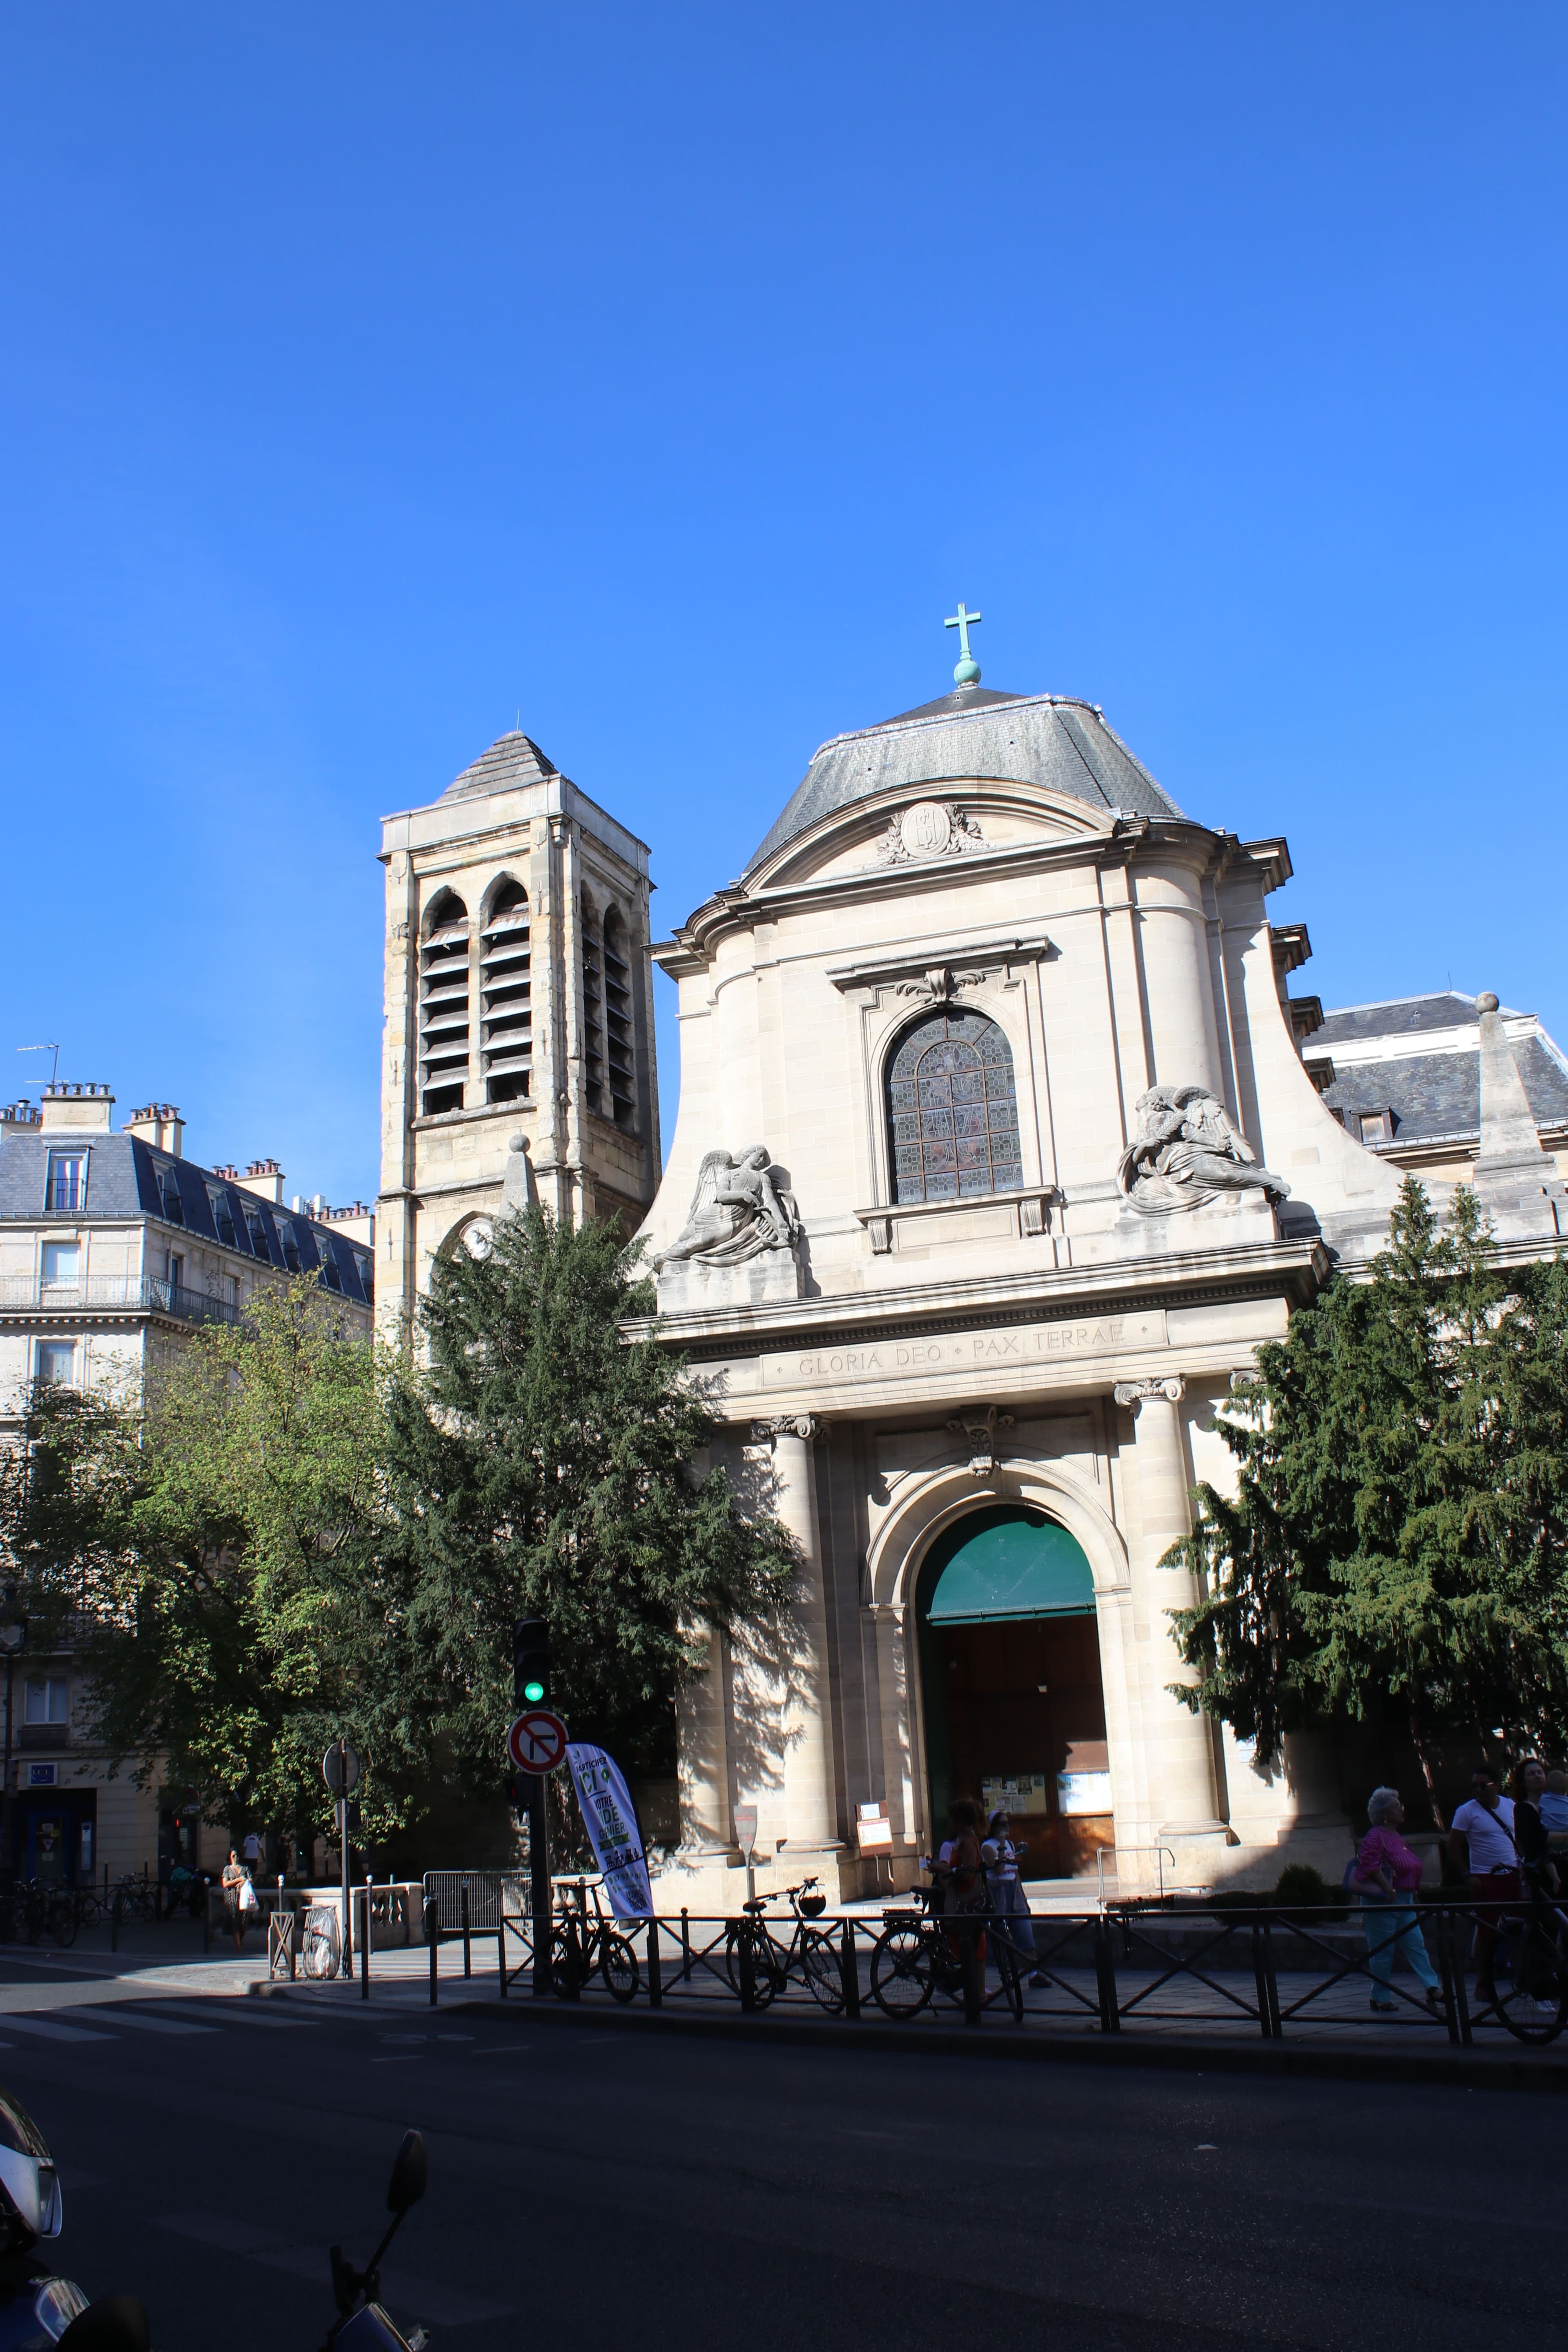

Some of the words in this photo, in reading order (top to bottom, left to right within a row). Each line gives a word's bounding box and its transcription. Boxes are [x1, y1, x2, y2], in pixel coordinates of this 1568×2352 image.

[799, 1352, 882, 1375] GLORIA
[896, 1345, 941, 1365] DEO
[973, 1336, 1020, 1357] PAX
[1033, 1323, 1125, 1350] TERRAE
[579, 1769, 597, 1795] ICI
